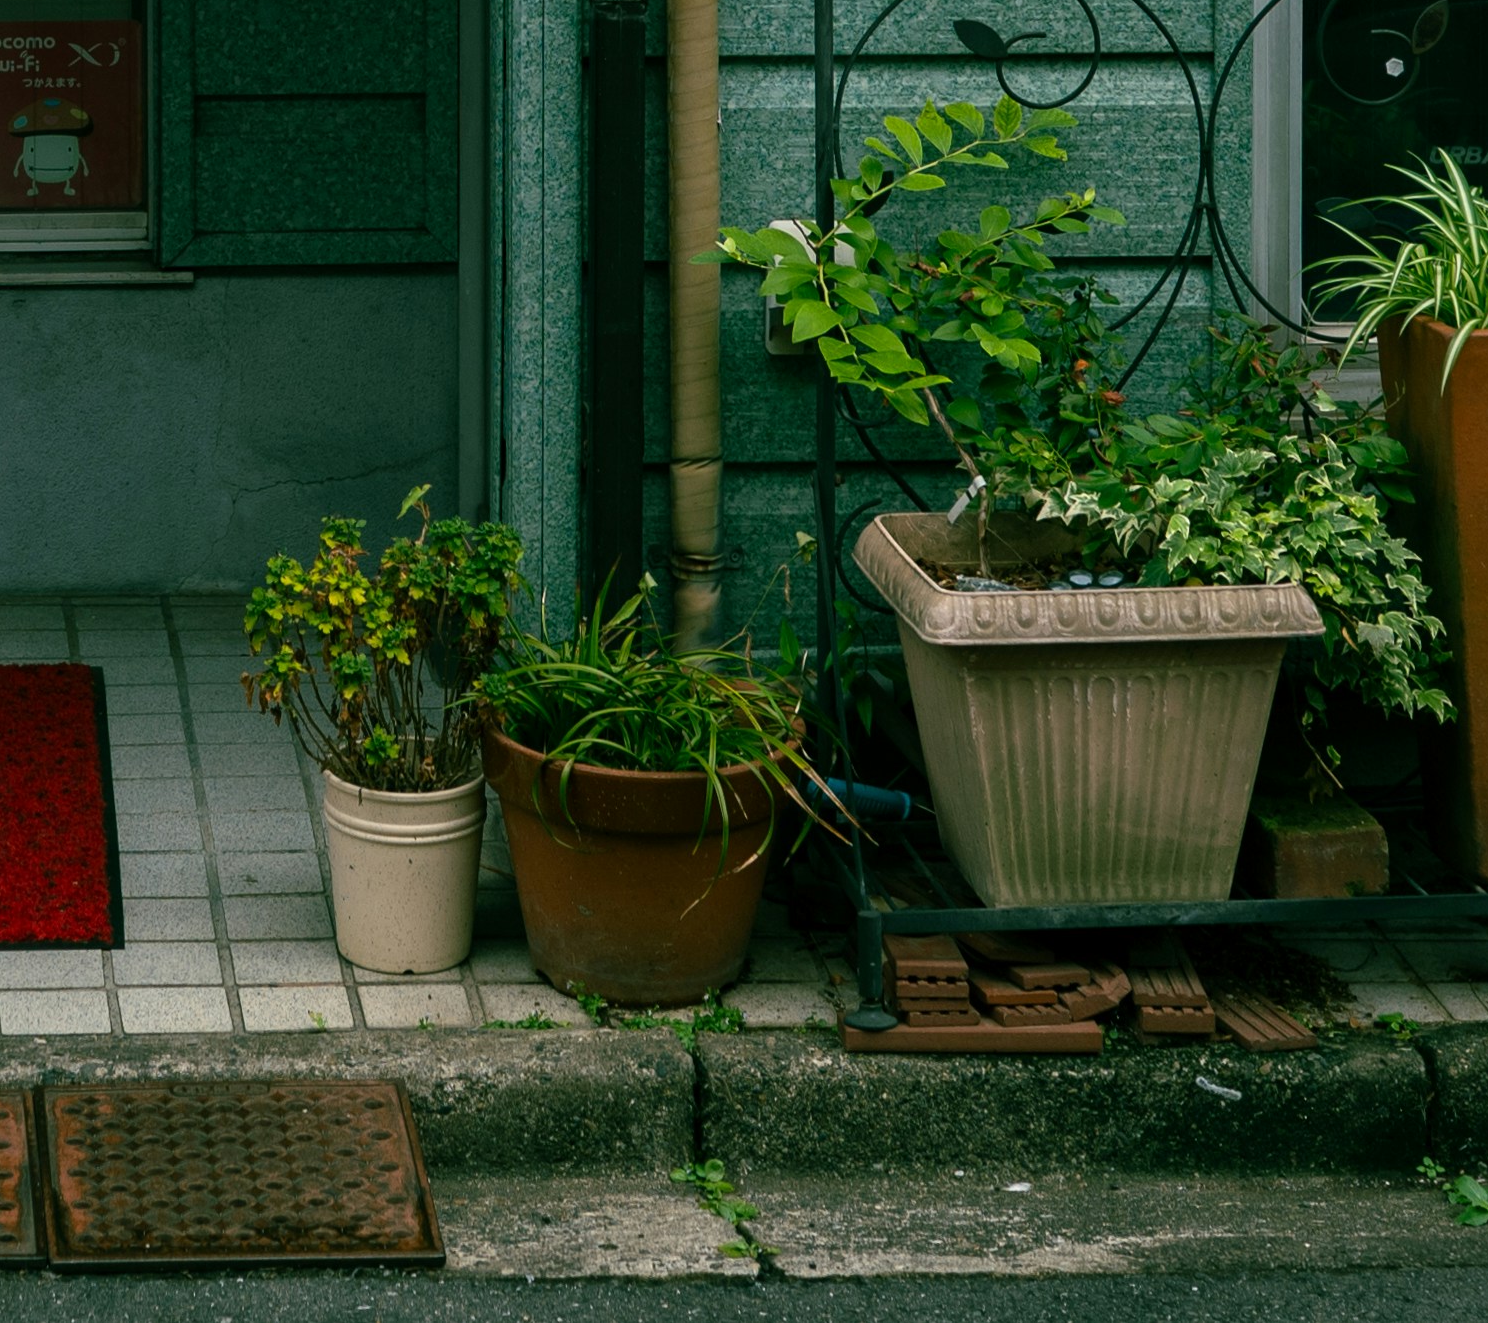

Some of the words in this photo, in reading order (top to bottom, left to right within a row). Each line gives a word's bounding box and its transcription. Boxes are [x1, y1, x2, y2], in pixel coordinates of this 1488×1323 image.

[68, 42, 121, 67] Xi
[22, 77, 82, 88] つかえます。
